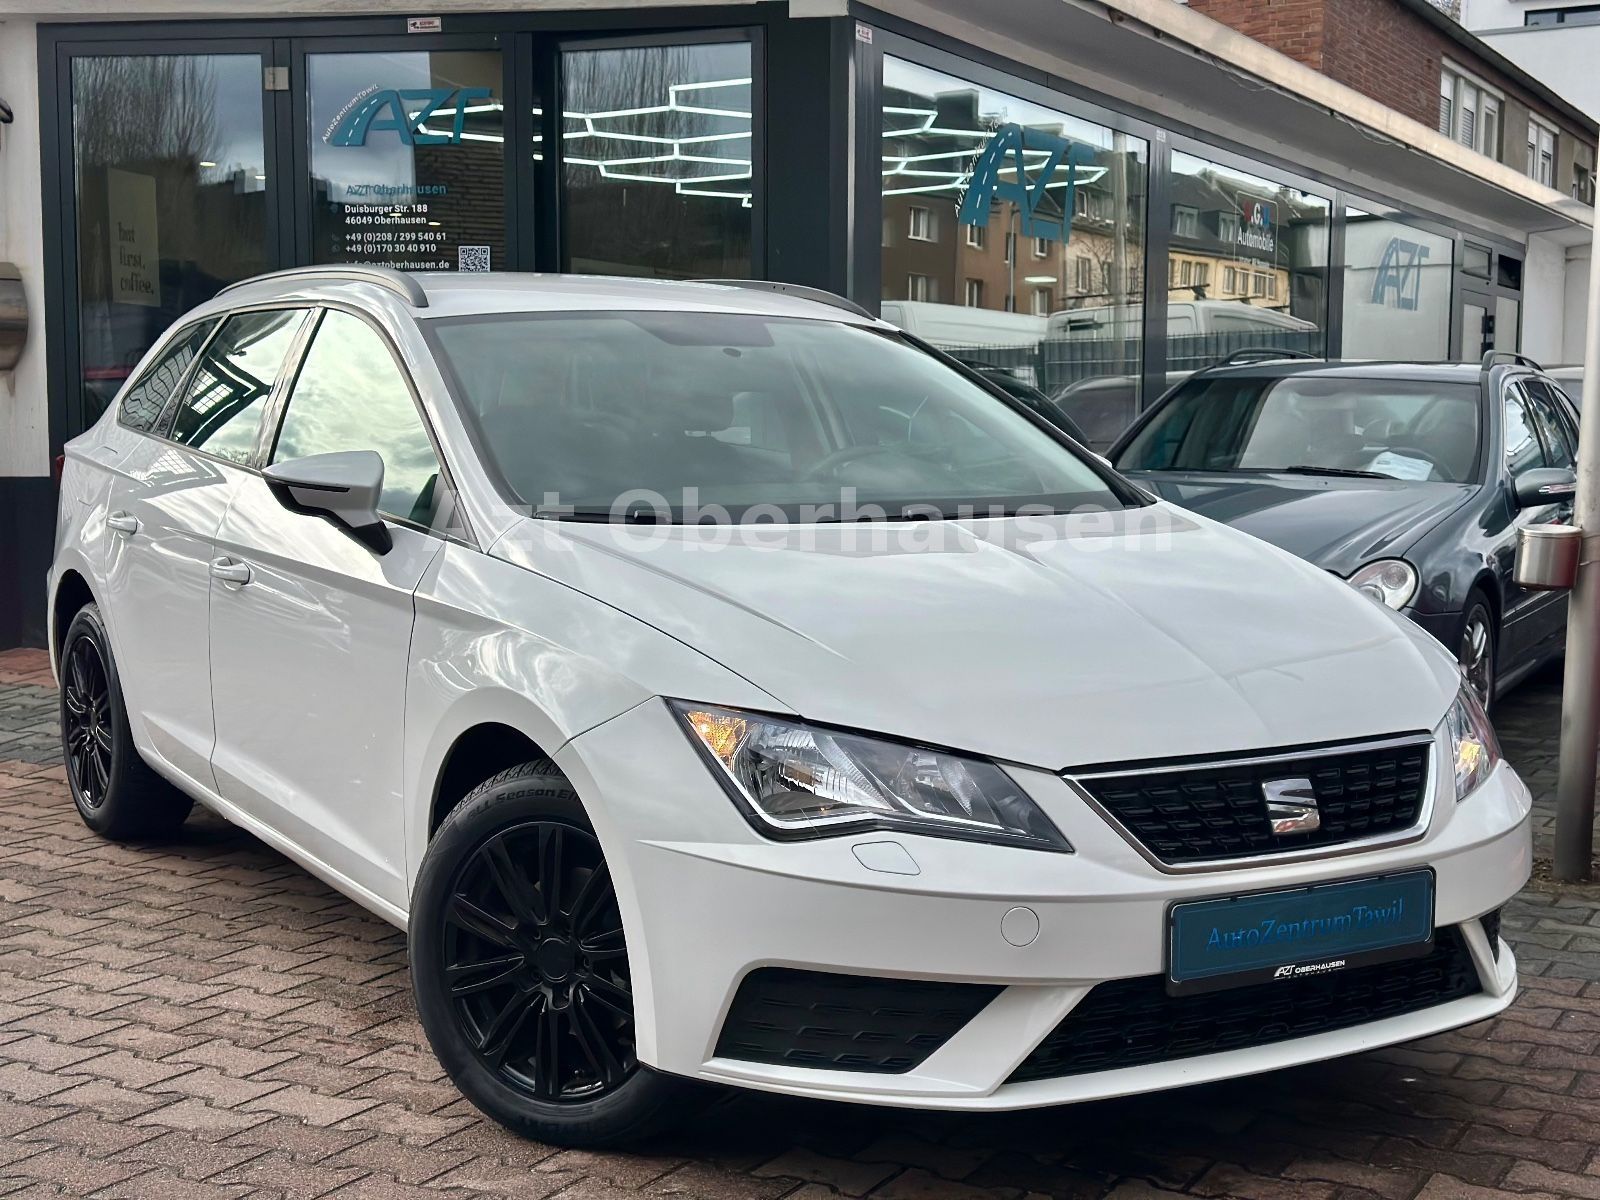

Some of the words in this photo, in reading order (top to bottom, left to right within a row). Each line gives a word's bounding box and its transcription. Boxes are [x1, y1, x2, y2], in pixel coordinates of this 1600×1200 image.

[331, 88, 493, 146] AZT
[959, 122, 1095, 247] AZT
[345, 204, 393, 214] Duisburger
[394, 204, 410, 213] Str.
[411, 204, 428, 213] 188
[345, 216, 372, 225] 46049
[374, 215, 427, 225] Oberhausen
[345, 232, 361, 241] +49
[363, 232, 392, 242] (0)208
[399, 232, 416, 241] 299
[417, 232, 435, 241] 540
[436, 232, 446, 241] 61
[1237, 225, 1274, 252] Automobile
[345, 244, 361, 253] +49
[363, 244, 393, 254] (0)170
[394, 244, 406, 252] 30
[406, 244, 418, 252] 40
[419, 244, 437, 252] 910
[1371, 236, 1430, 311] AZT
[495, 788, 556, 803] Season
